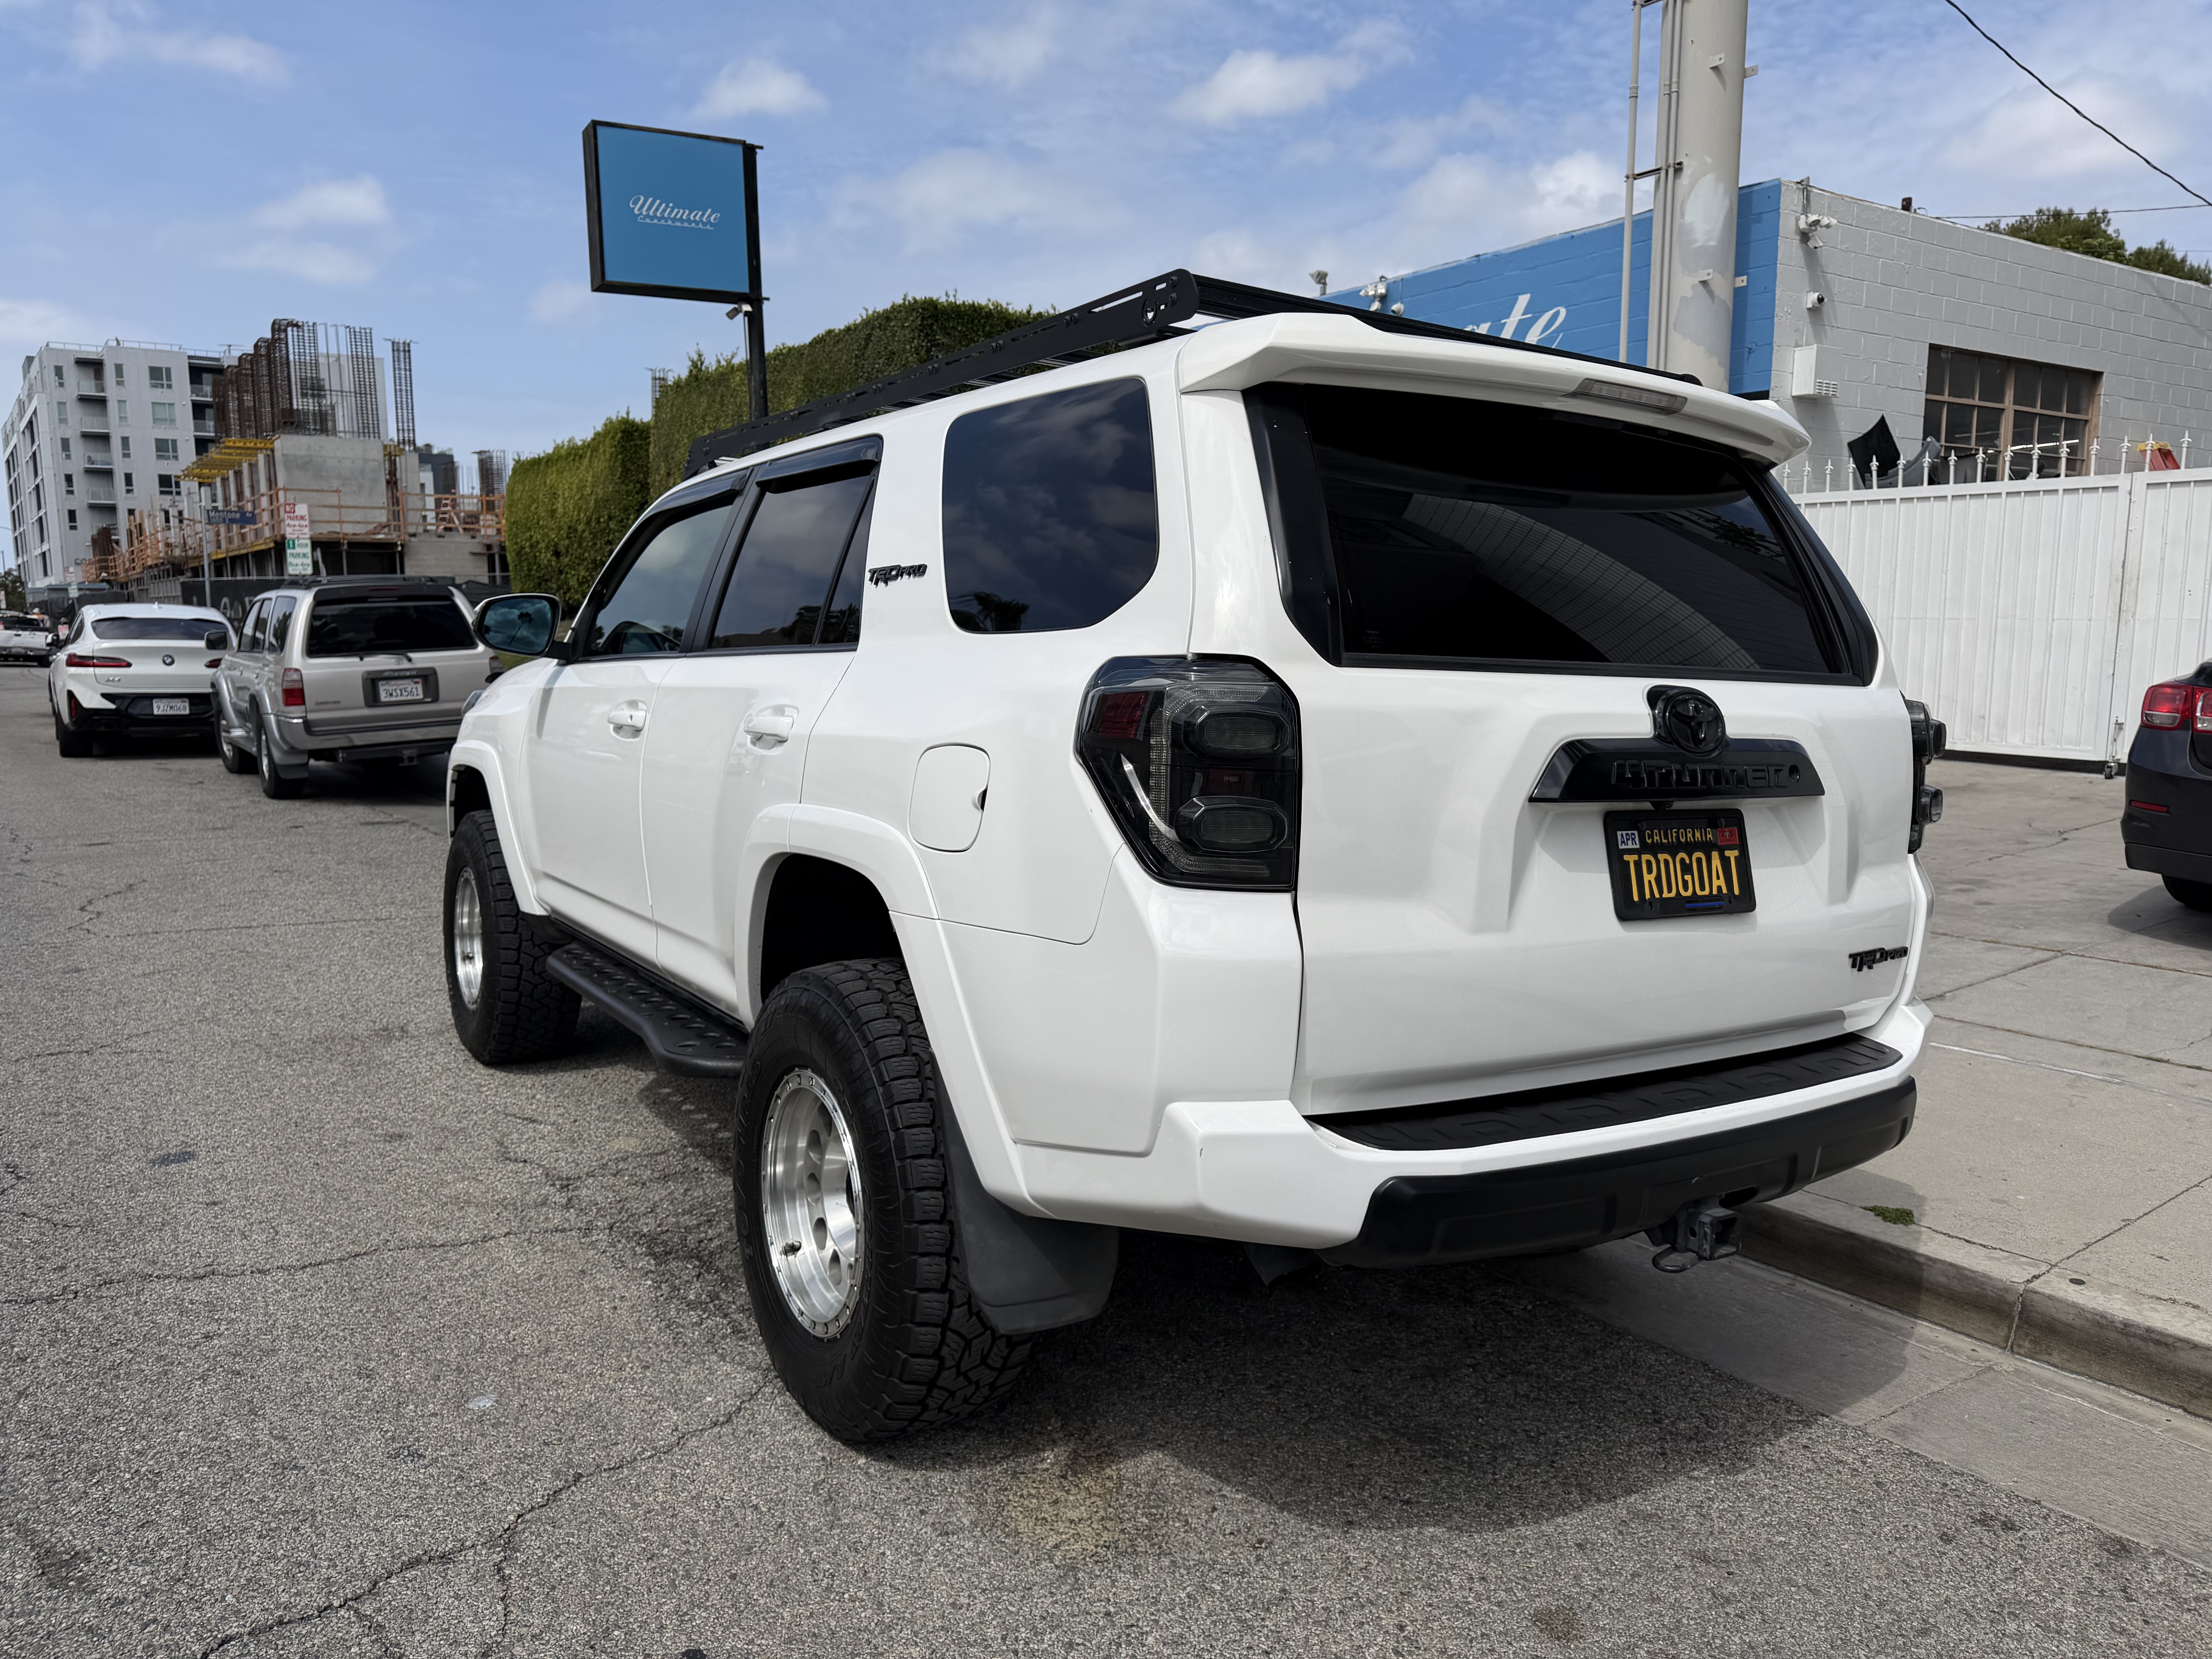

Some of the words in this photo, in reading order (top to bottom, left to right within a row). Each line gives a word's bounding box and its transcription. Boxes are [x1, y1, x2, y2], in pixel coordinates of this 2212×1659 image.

[629, 195, 720, 223] Ultimate
[209, 510, 241, 519] Mentone
[285, 504, 294, 512] NO
[1620, 832, 1637, 846] APR
[1645, 828, 1713, 843] CALIFORNIA
[1623, 850, 1739, 902] TRDGOAT
